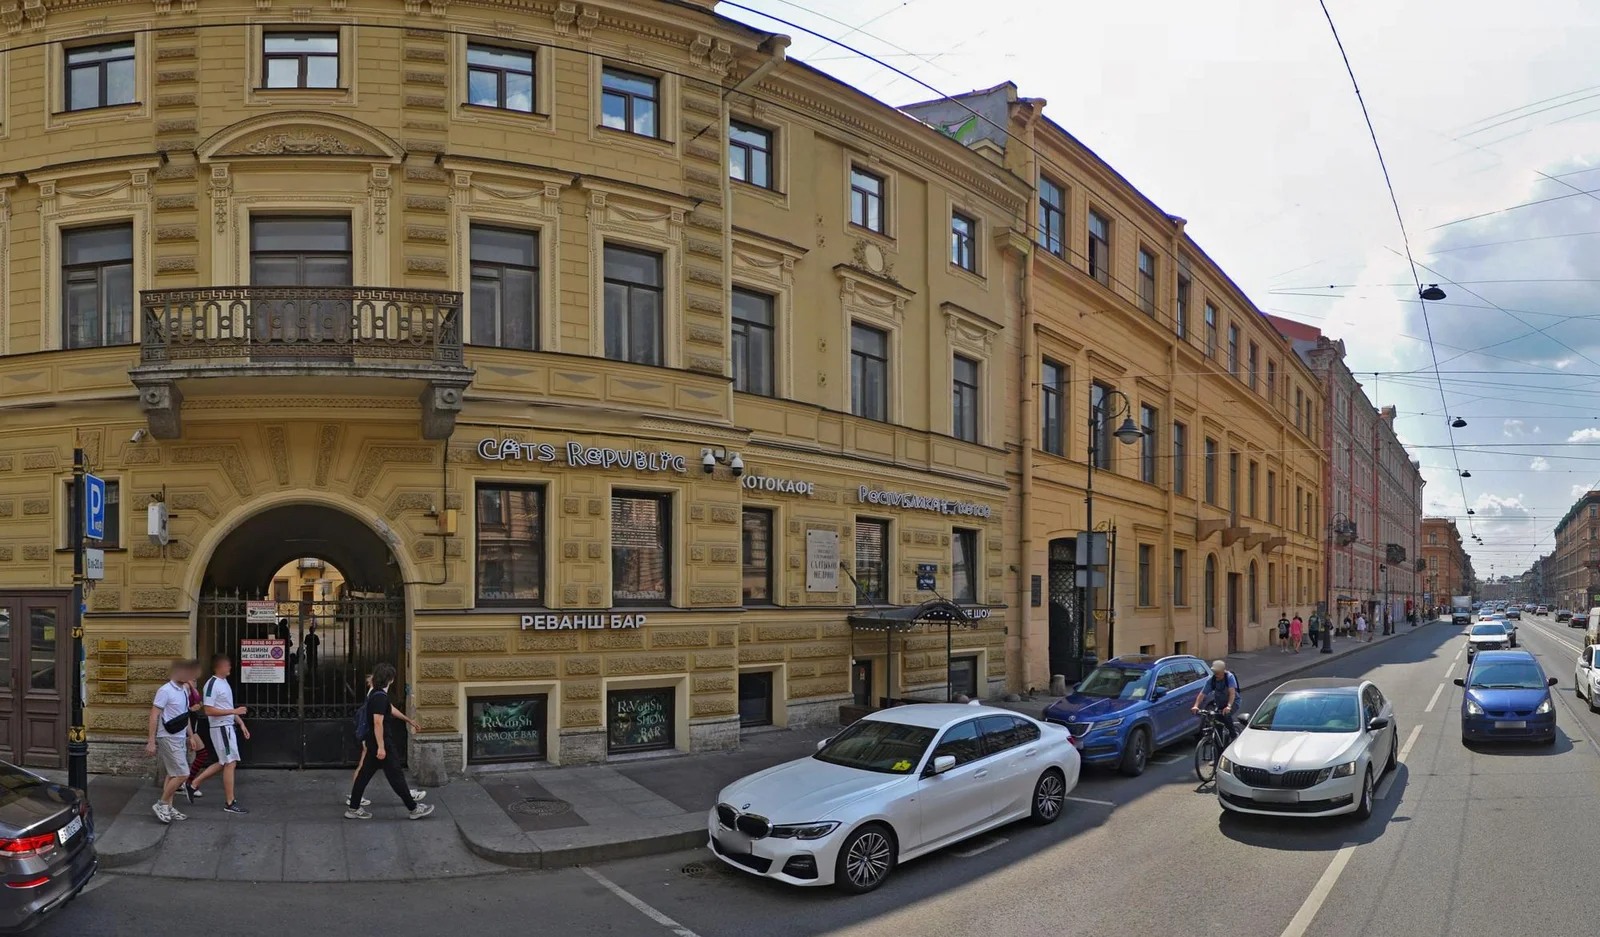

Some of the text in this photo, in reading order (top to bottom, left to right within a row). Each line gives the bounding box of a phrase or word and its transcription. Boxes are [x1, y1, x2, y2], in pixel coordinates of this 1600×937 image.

[973, 609, 992, 618] ШОУ
[521, 614, 647, 630] РЕВАНШ БАР
[476, 730, 537, 742] KARAOKE BAR
[640, 726, 661, 737] BAR
